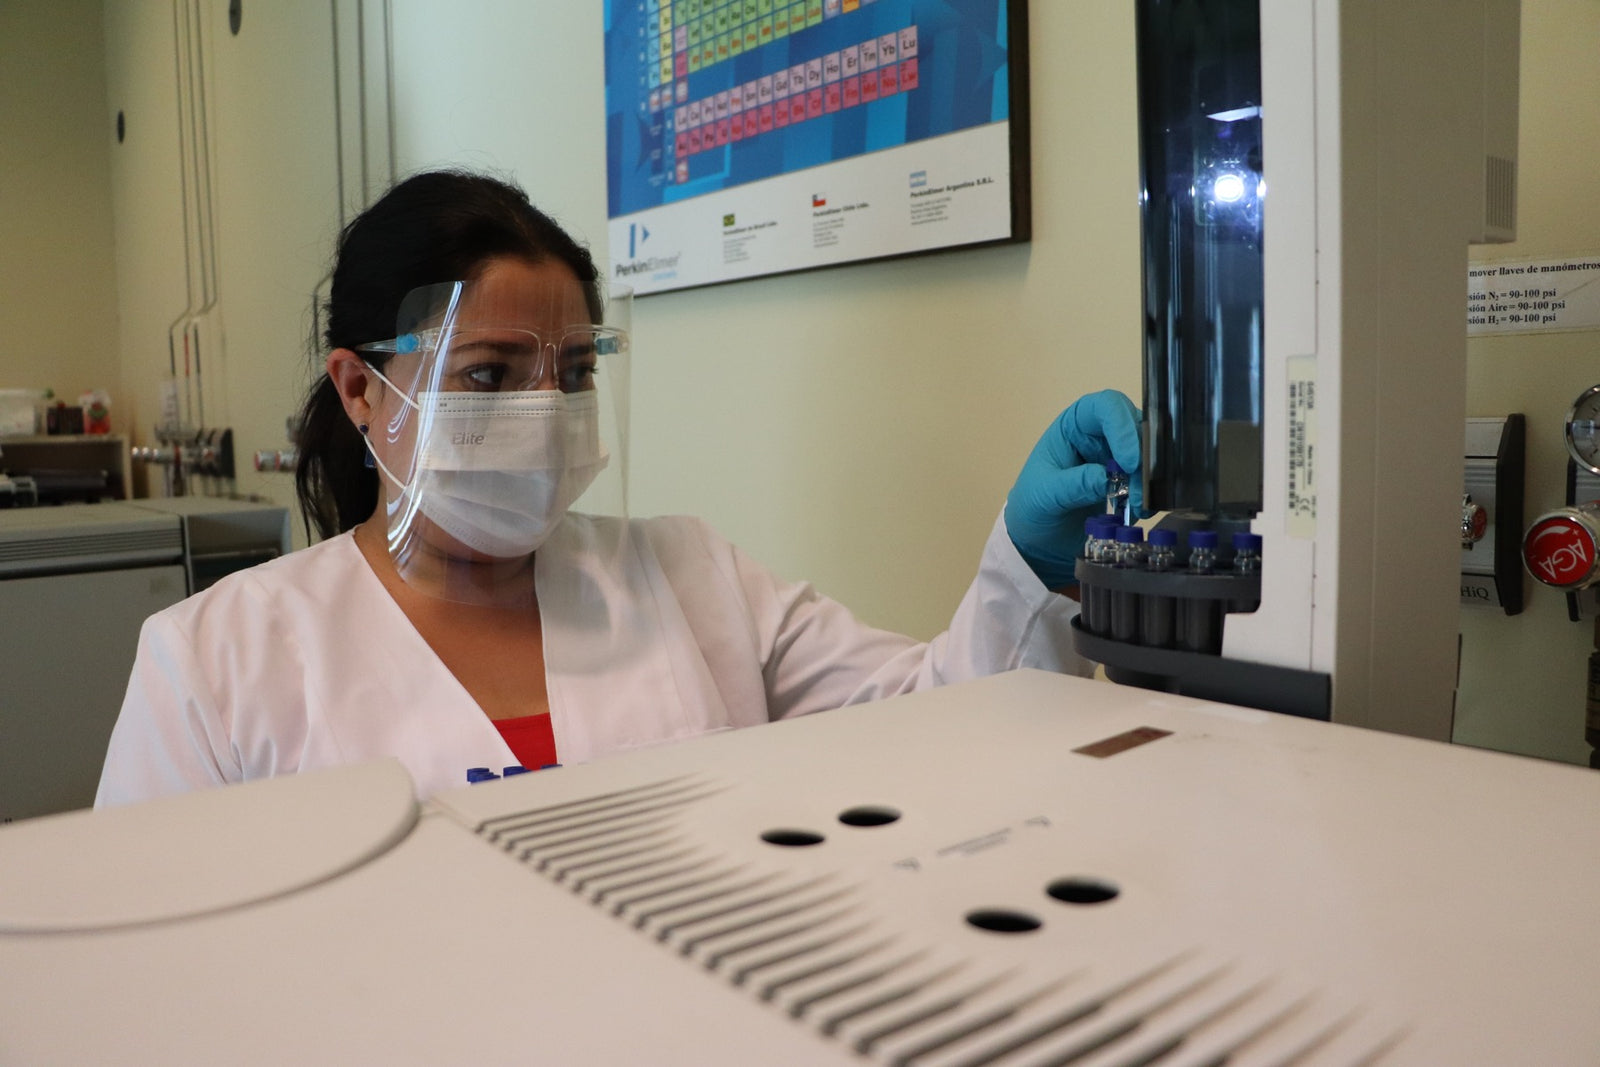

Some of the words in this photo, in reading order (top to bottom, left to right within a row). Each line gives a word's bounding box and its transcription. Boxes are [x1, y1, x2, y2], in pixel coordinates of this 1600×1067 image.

[776, 81, 787, 91] Gd
[809, 71, 819, 81] Dy
[827, 64, 838, 74] Ho
[847, 58, 857, 68] Er
[864, 51, 876, 61] Tm
[883, 45, 895, 56] Yb
[903, 39, 915, 49] Lu
[946, 182, 975, 192] Argentina
[976, 177, 994, 185] S.R.L.
[616, 256, 680, 277] PerkinElmer
[1469, 269, 1496, 277] mover
[1499, 267, 1524, 276] llaves
[1527, 265, 1538, 273] de
[1541, 262, 1600, 273] manómetros
[1509, 289, 1540, 298] 90-100
[1542, 288, 1557, 299] psi
[1488, 303, 1508, 312] Aire
[1517, 301, 1549, 310] 90-100
[1551, 300, 1566, 311] psi
[1509, 313, 1540, 323] 90-100
[1542, 312, 1557, 324] psi
[1538, 538, 1588, 579] AGA
[1460, 584, 1489, 600] HiQ
